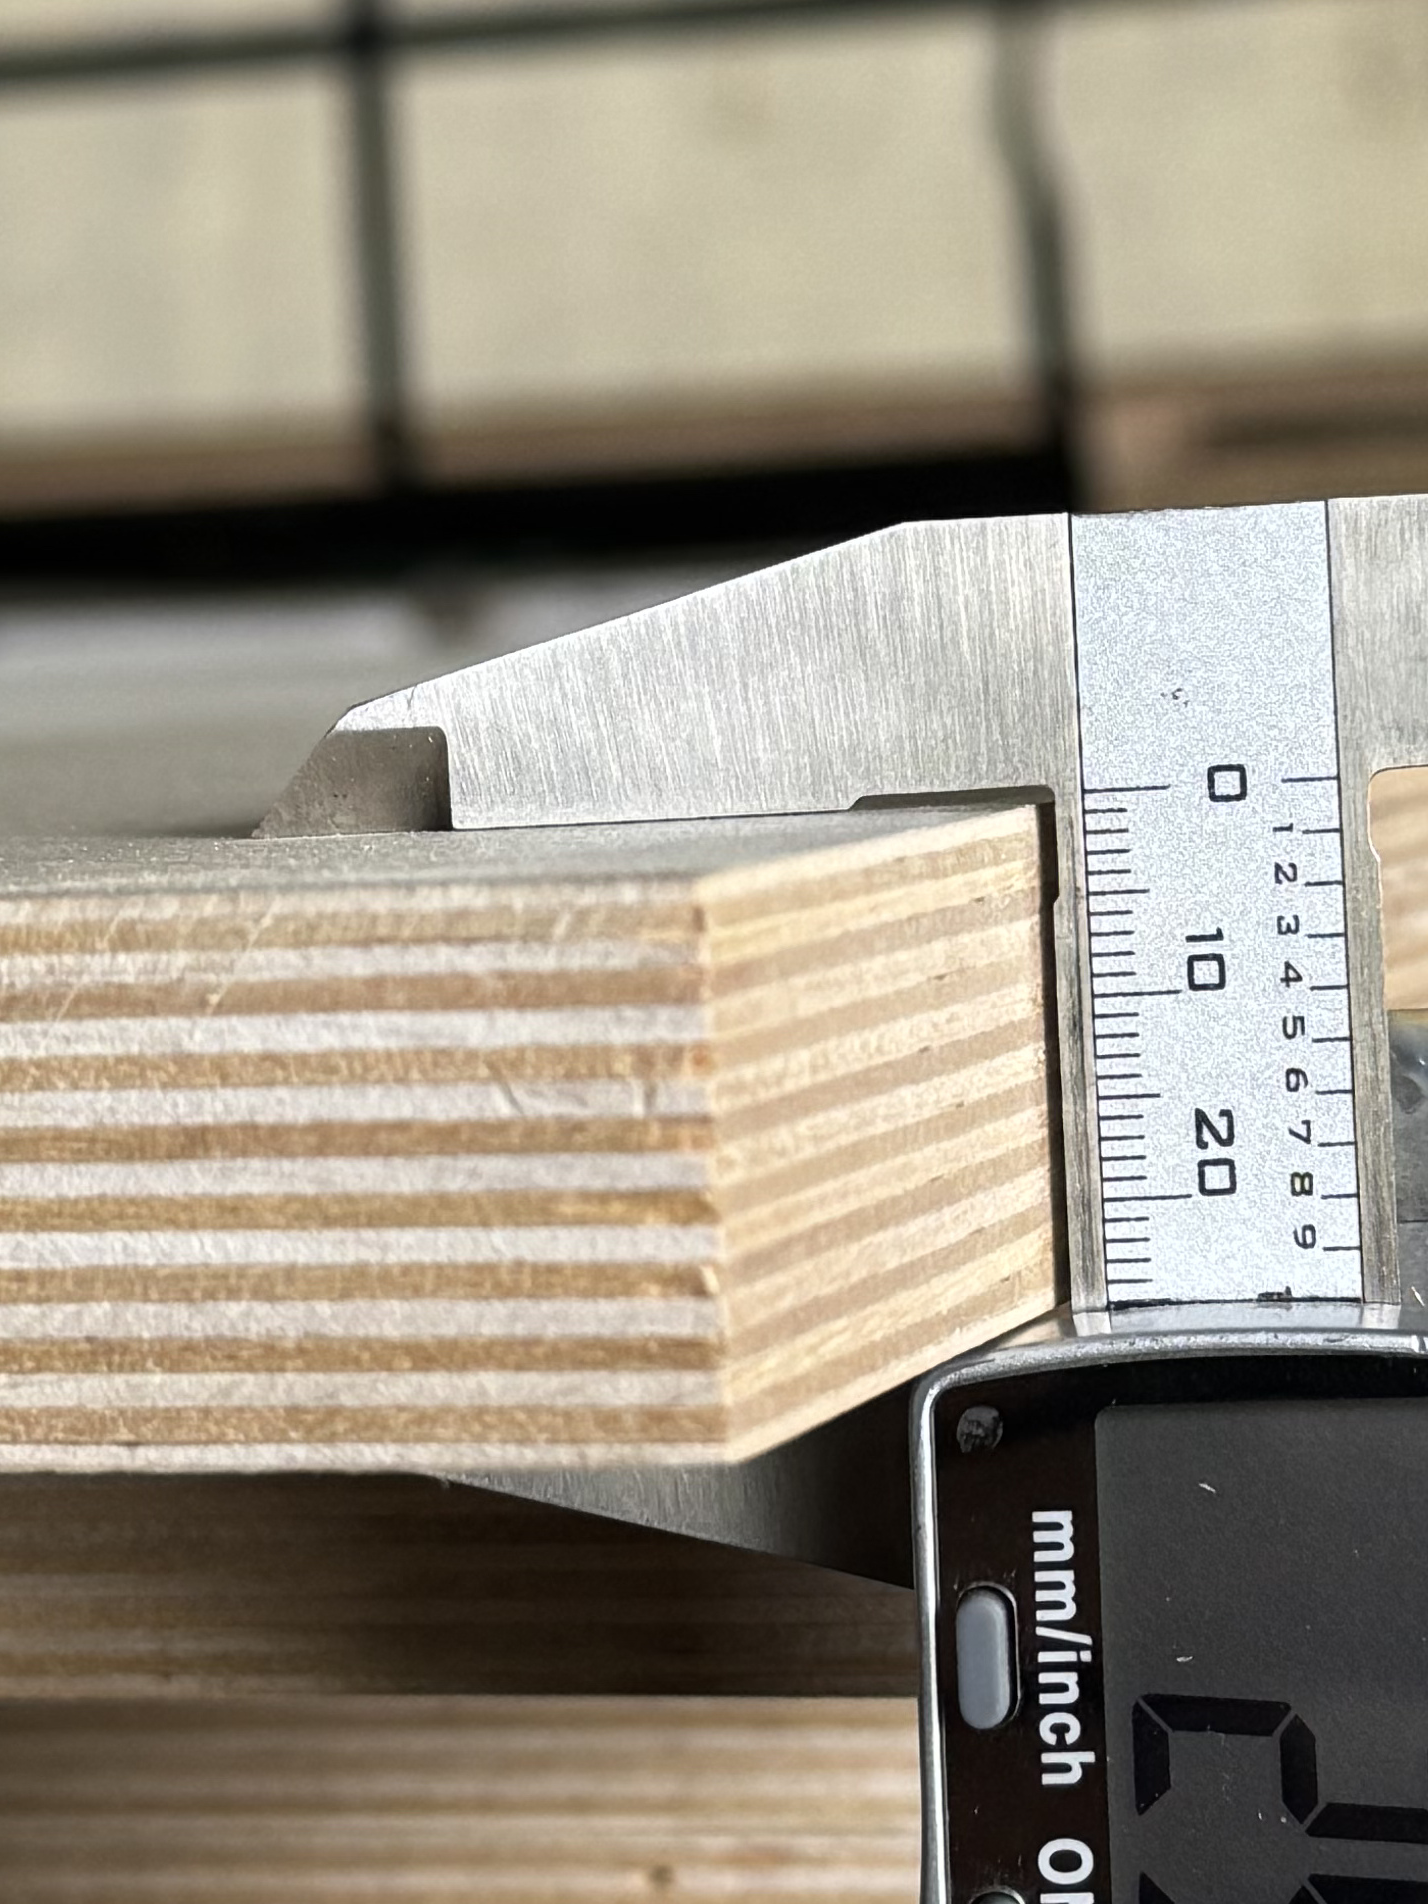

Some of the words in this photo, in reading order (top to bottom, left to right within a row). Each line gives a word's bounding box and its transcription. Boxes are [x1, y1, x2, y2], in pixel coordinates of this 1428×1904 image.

[1206, 763, 1249, 804] 0
[1272, 822, 1294, 834] 1
[1274, 862, 1298, 885] 2
[1276, 914, 1300, 937] 3
[1184, 927, 1227, 993] 10
[1280, 959, 1304, 988] 4
[1282, 1015, 1306, 1041] 5
[1285, 1067, 1309, 1093] 6
[1288, 1119, 1312, 1145] 7
[1194, 1108, 1238, 1198] 20
[1290, 1171, 1314, 1197] 8
[1293, 1224, 1317, 1250] 9
[1032, 1509, 1096, 1786] mm/inch
